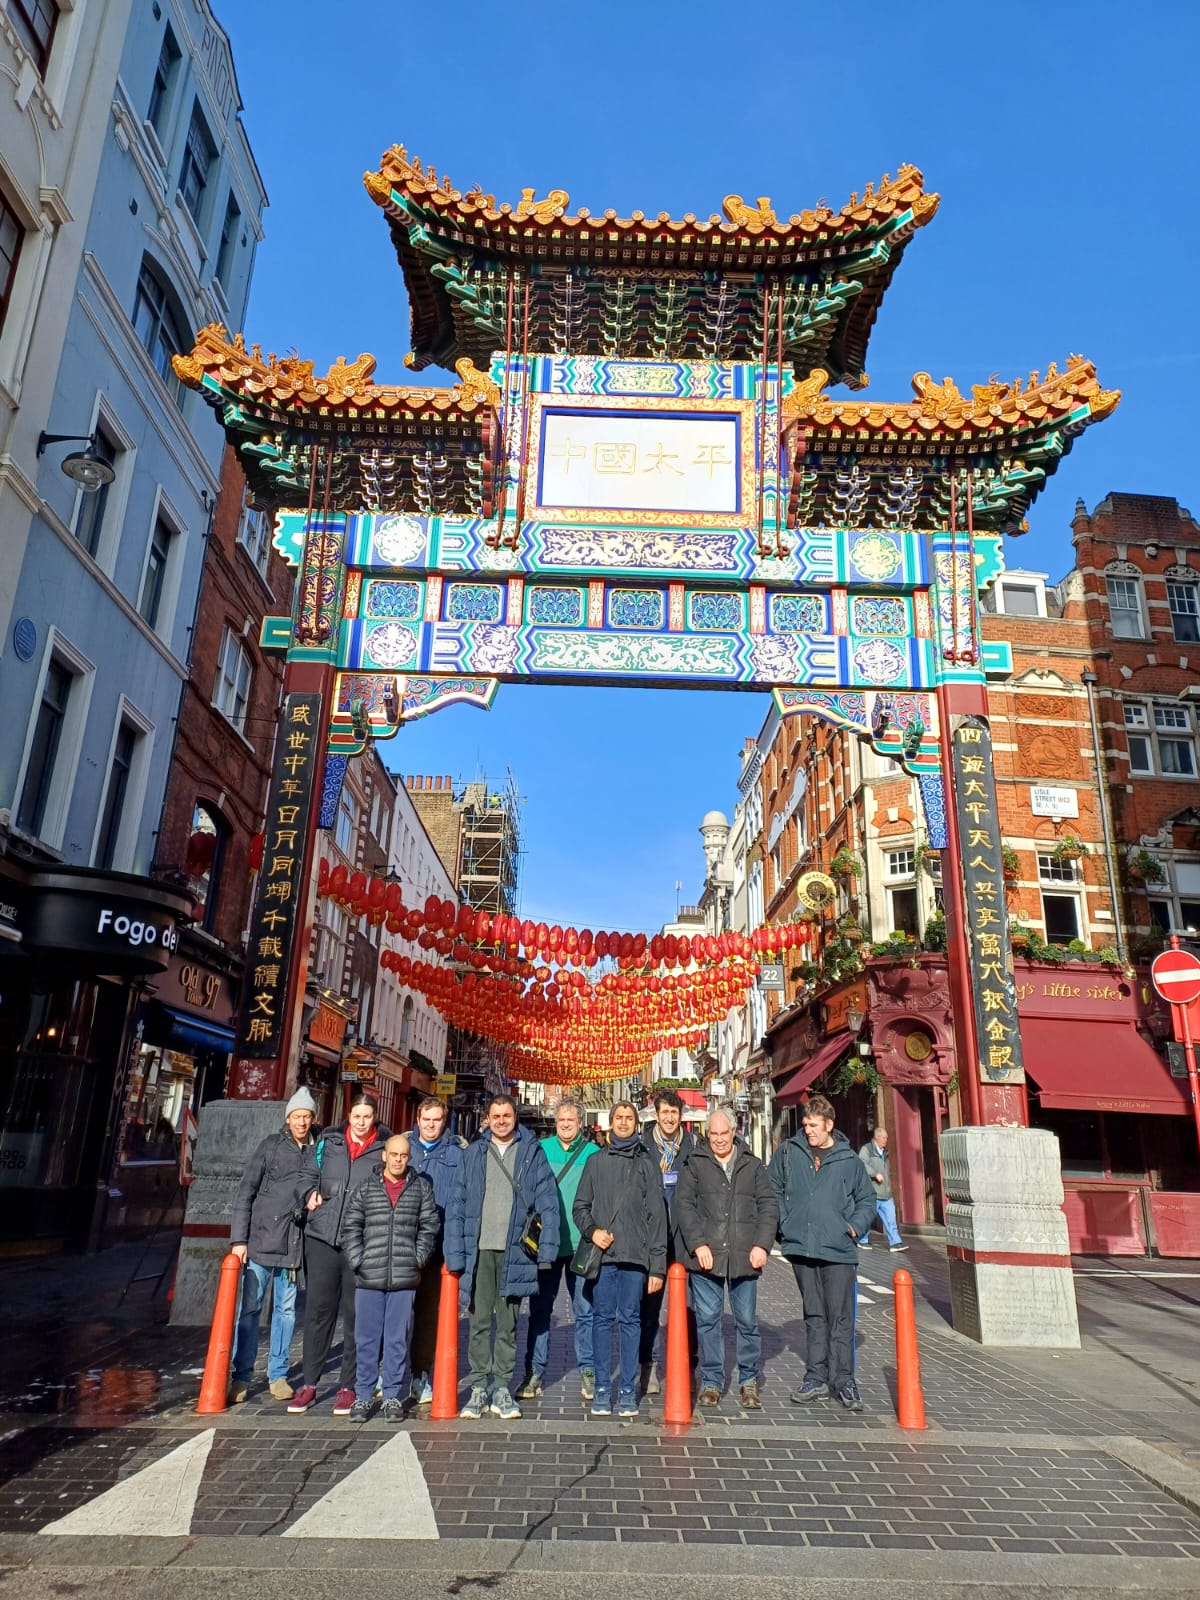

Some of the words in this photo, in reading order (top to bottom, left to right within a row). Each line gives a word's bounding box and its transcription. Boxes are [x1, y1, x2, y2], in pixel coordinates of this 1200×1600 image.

[550, 436, 733, 481] 中國太平
[97, 909, 157, 946] Fogo
[182, 965, 200, 989] Old
[763, 970, 778, 981] 22
[203, 975, 222, 1010] 97
[1015, 982, 1035, 1001] y's
[1042, 983, 1081, 998] Little
